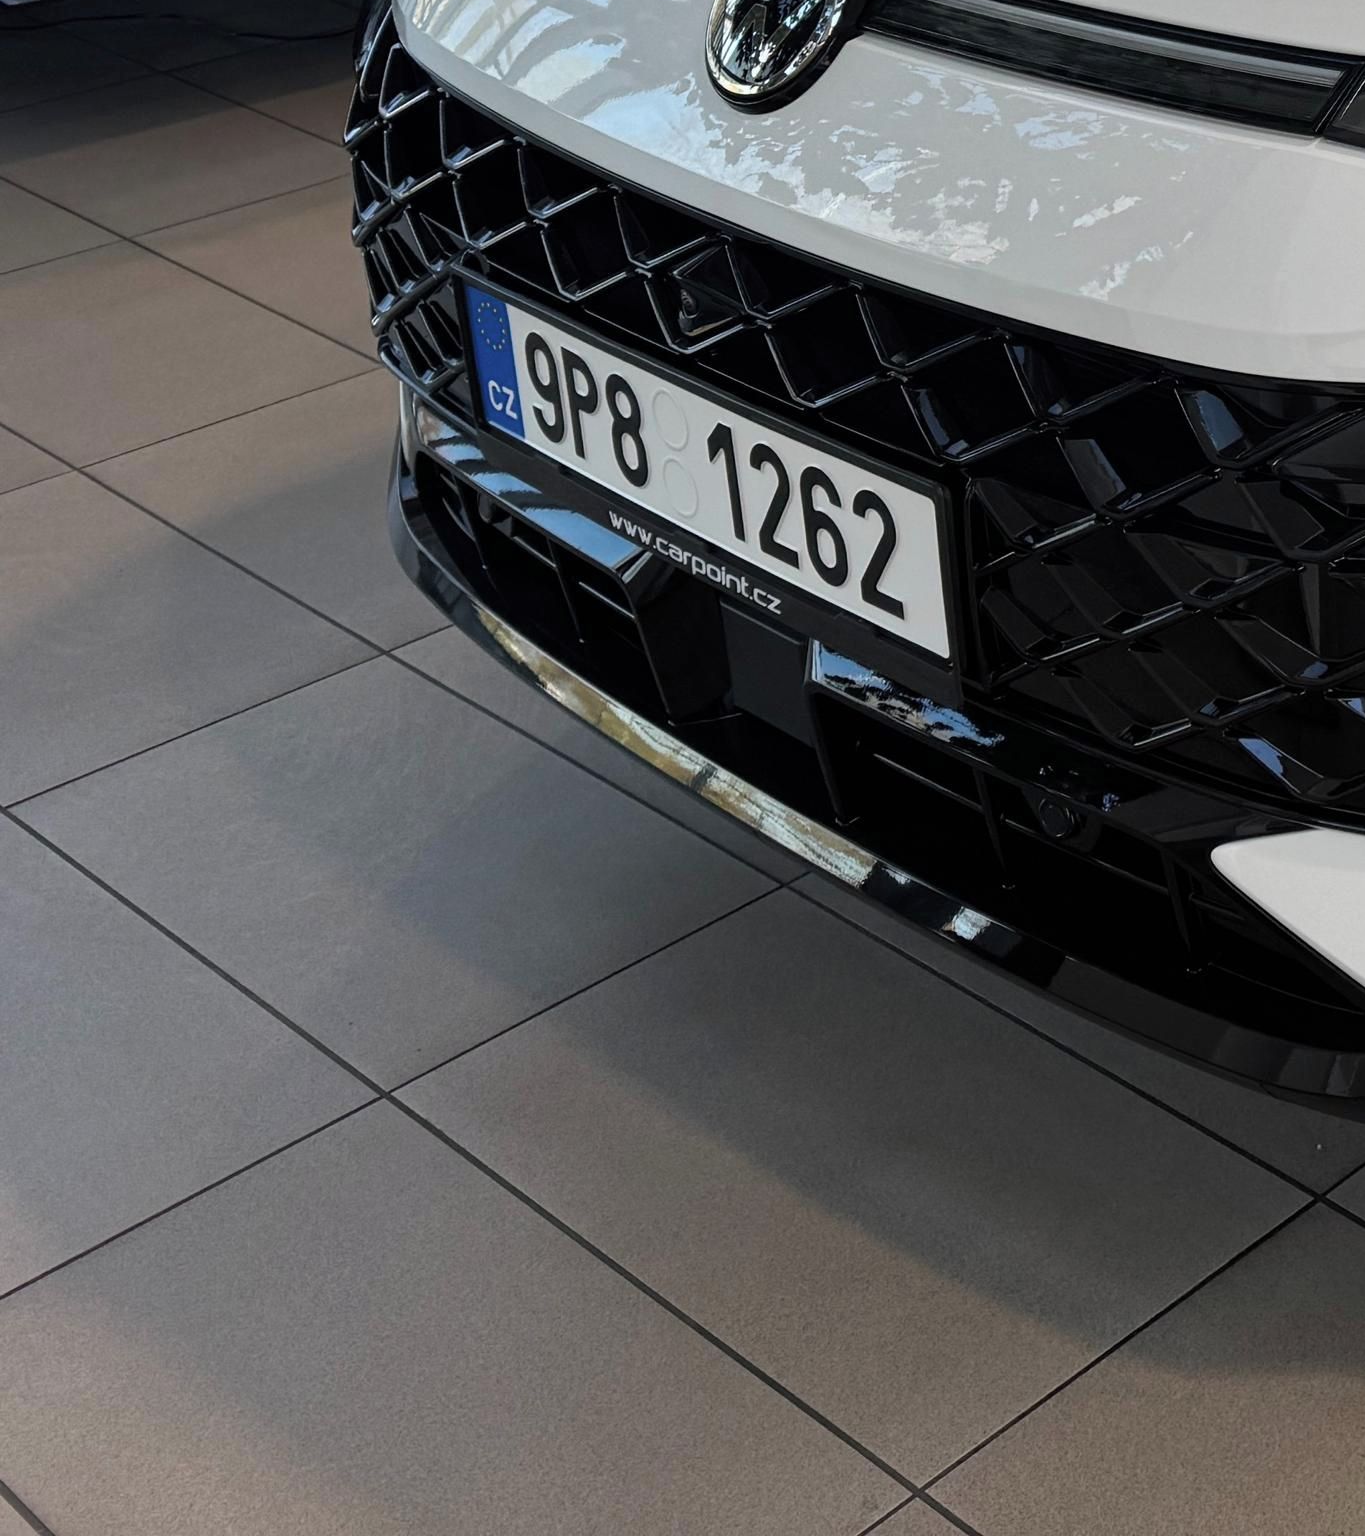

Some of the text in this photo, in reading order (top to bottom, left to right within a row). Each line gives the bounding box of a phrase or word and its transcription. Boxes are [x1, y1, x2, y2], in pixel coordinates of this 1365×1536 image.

[487, 379, 518, 419] CZ
[524, 331, 907, 621] 9P8 1262
[608, 509, 783, 616] www.carpoint.cz
